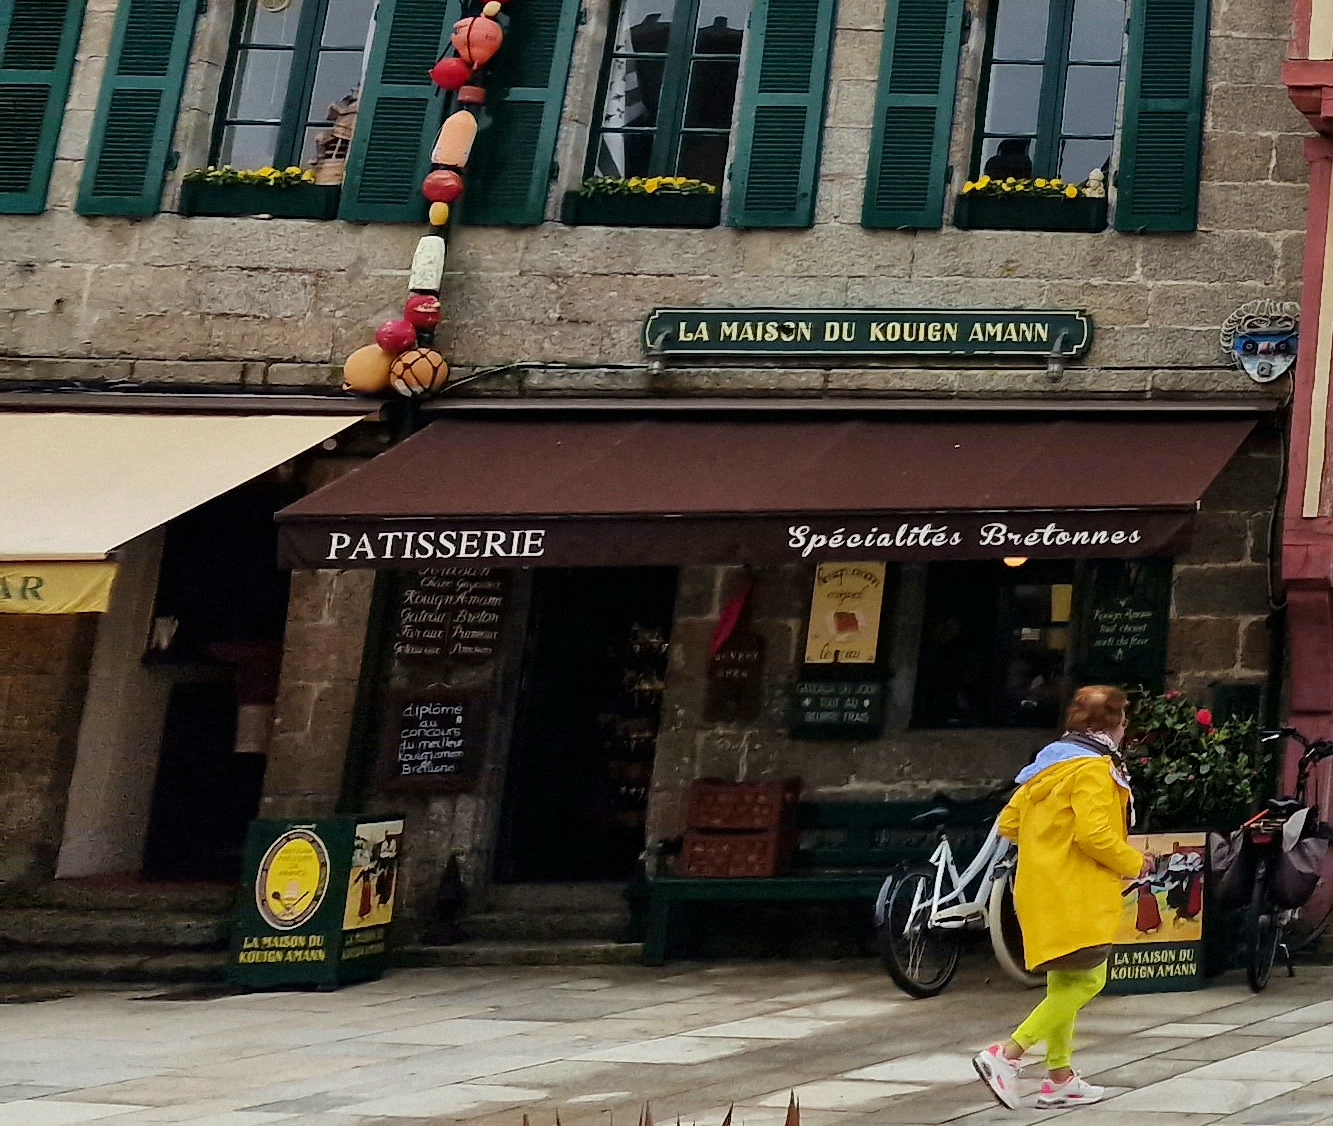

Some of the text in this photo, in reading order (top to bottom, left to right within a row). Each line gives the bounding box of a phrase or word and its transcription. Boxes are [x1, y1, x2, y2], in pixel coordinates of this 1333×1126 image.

[678, 321, 1049, 342] LA MAISON DU KOUIGN AMANN
[325, 529, 546, 560] PATISSERIE
[788, 522, 1142, 558] Spécialités Bretonnes
[1114, 948, 1194, 965] LA MAISON DU
[1110, 962, 1197, 980] KOUIGN AMANN
